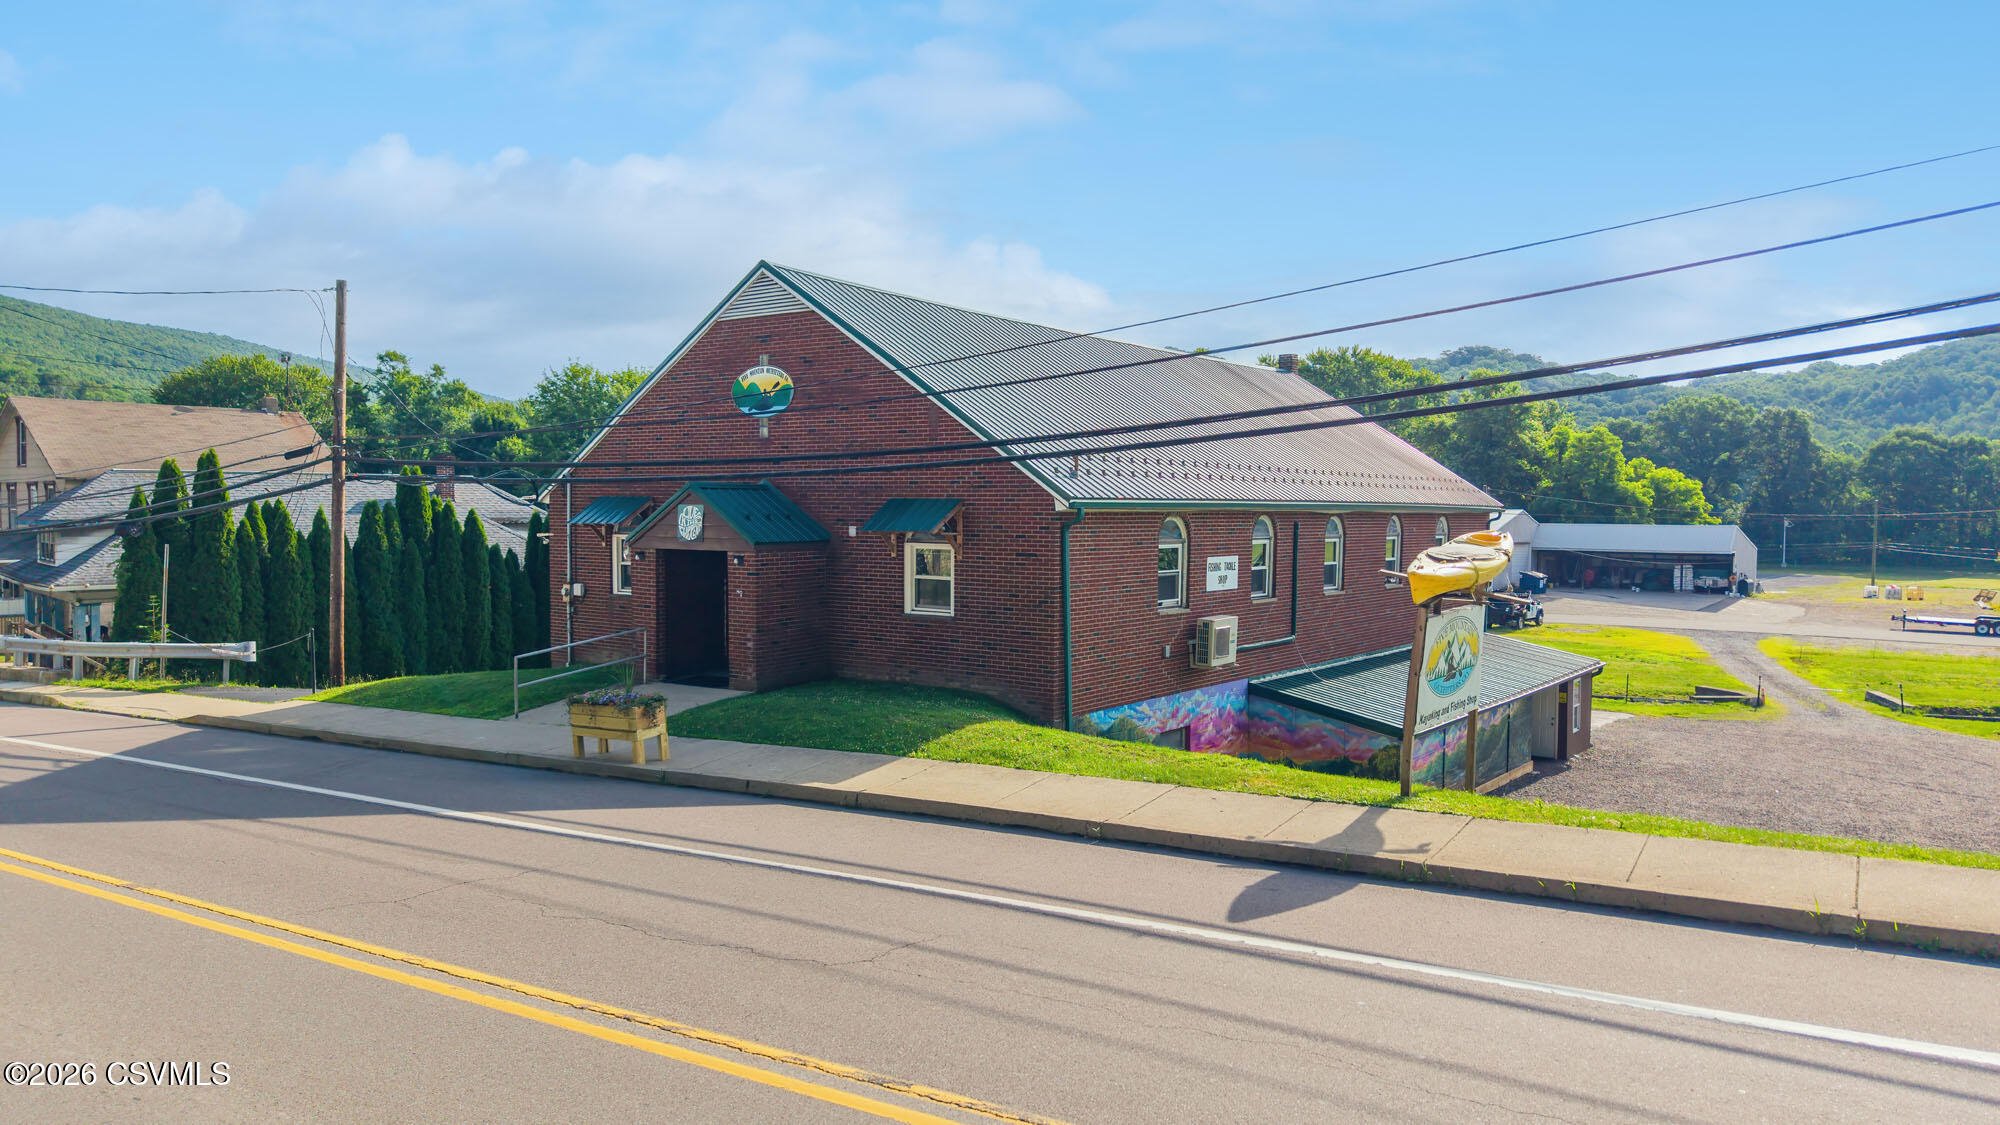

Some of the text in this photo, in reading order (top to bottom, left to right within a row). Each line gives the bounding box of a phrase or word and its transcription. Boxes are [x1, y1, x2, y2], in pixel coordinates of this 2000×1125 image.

[1418, 695, 1478, 726] Kayaking and Fishing Shop
